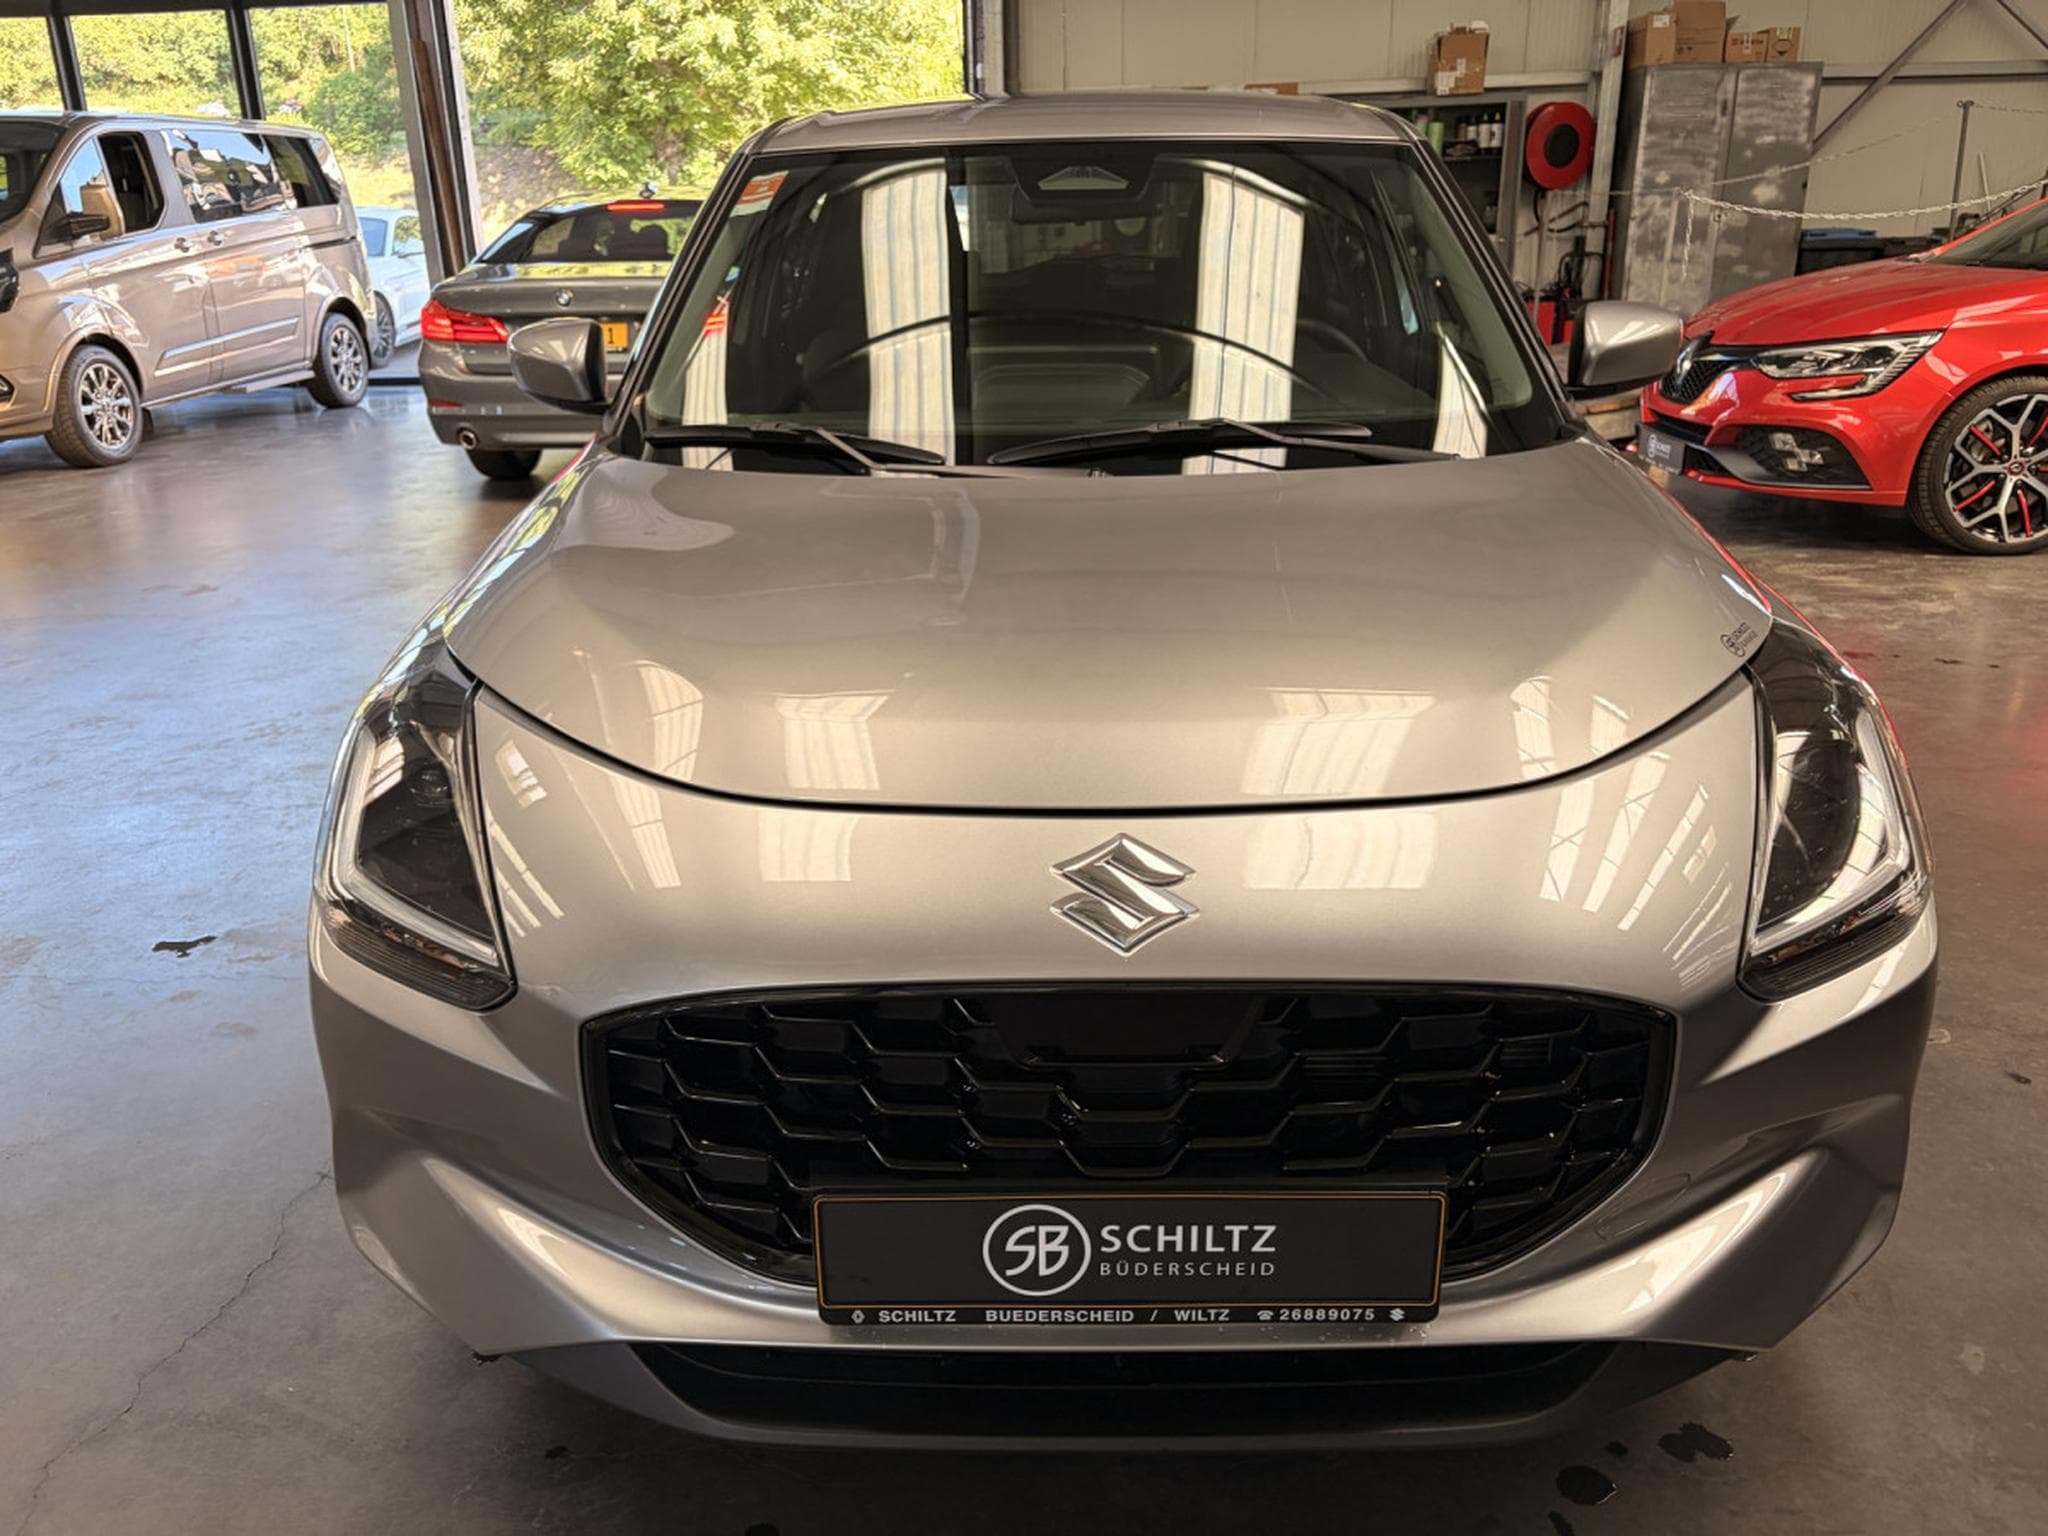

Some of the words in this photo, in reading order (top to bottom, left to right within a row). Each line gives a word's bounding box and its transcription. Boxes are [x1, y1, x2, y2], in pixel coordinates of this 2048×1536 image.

[1100, 1224, 1277, 1253] SCHILTZ
[1004, 1225, 1070, 1277] SB
[1100, 1260, 1275, 1276] BÜDERSCHEID
[878, 1310, 957, 1323] SCHILTZ
[985, 1309, 1135, 1322] BUEDERSCHEID
[1174, 1308, 1230, 1322] WILTZ
[1279, 1308, 1376, 1321] 26889075
